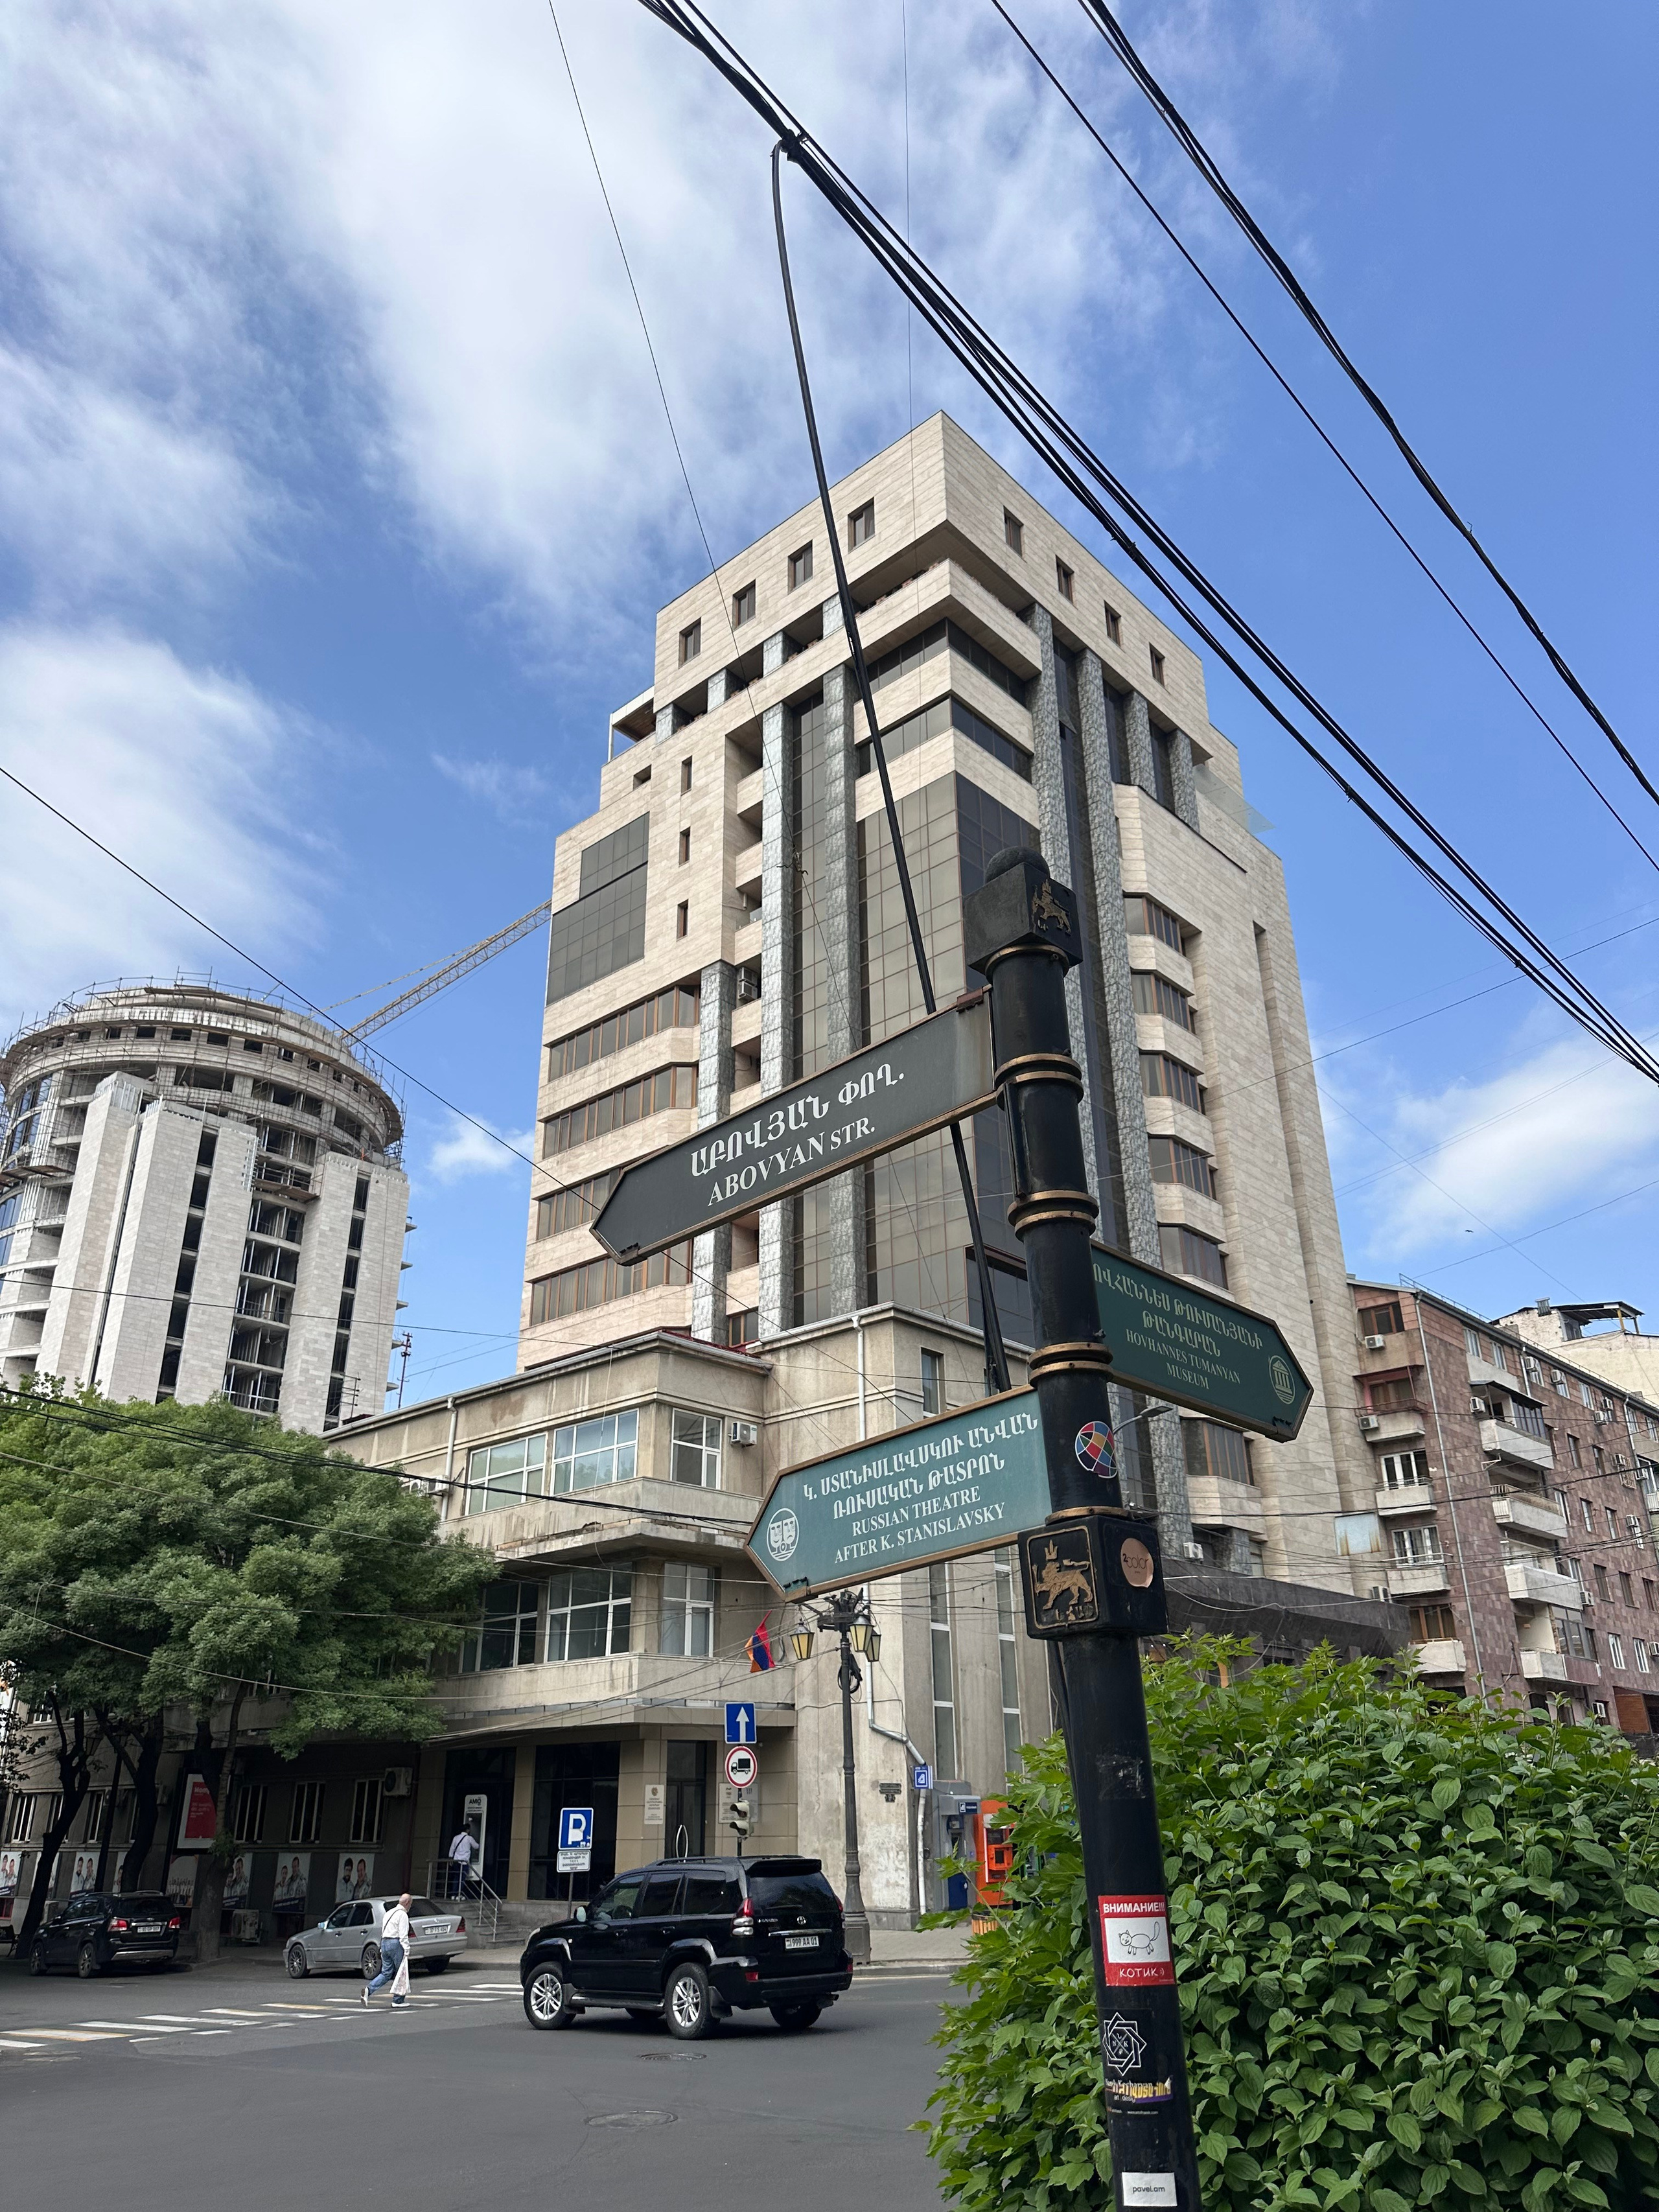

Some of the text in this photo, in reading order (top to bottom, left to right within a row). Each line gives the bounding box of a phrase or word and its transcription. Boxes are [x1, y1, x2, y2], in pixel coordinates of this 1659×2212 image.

[691, 1063, 905, 1177] ԱԲՈՎՅԱՆ ՓՈՂ.
[708, 1117, 876, 1207] ABOVYAN STR.
[1093, 1263, 1264, 1350] ՈՎՀԱՆՆԵՍ ԹՈՒՄԱՆՅԱՆԻ
[1143, 1310, 1221, 1357] ԹԱՆԳԱՐԱՆ
[1126, 1329, 1241, 1384] HOVHANNES TUMANYAN
[1166, 1362, 1210, 1390] MUSEUM
[803, 1412, 1038, 1500] Կ. ՍՏԱՆԻՍԼԱՎՍԿՈՒ ԱՆՎԱՆ
[833, 1452, 1005, 1520] ՌՈՒՍԱԿԱՆ ԹԱՏՐՈՆ
[852, 1485, 981, 1537] RUSSIAN THEATRE
[834, 1502, 1005, 1564] AFTER K. STANISLAVSKY
[1103, 1902, 1165, 1913] ВНИМАНИЕ!!!
[1132, 2185, 1166, 2195] pavel.am
